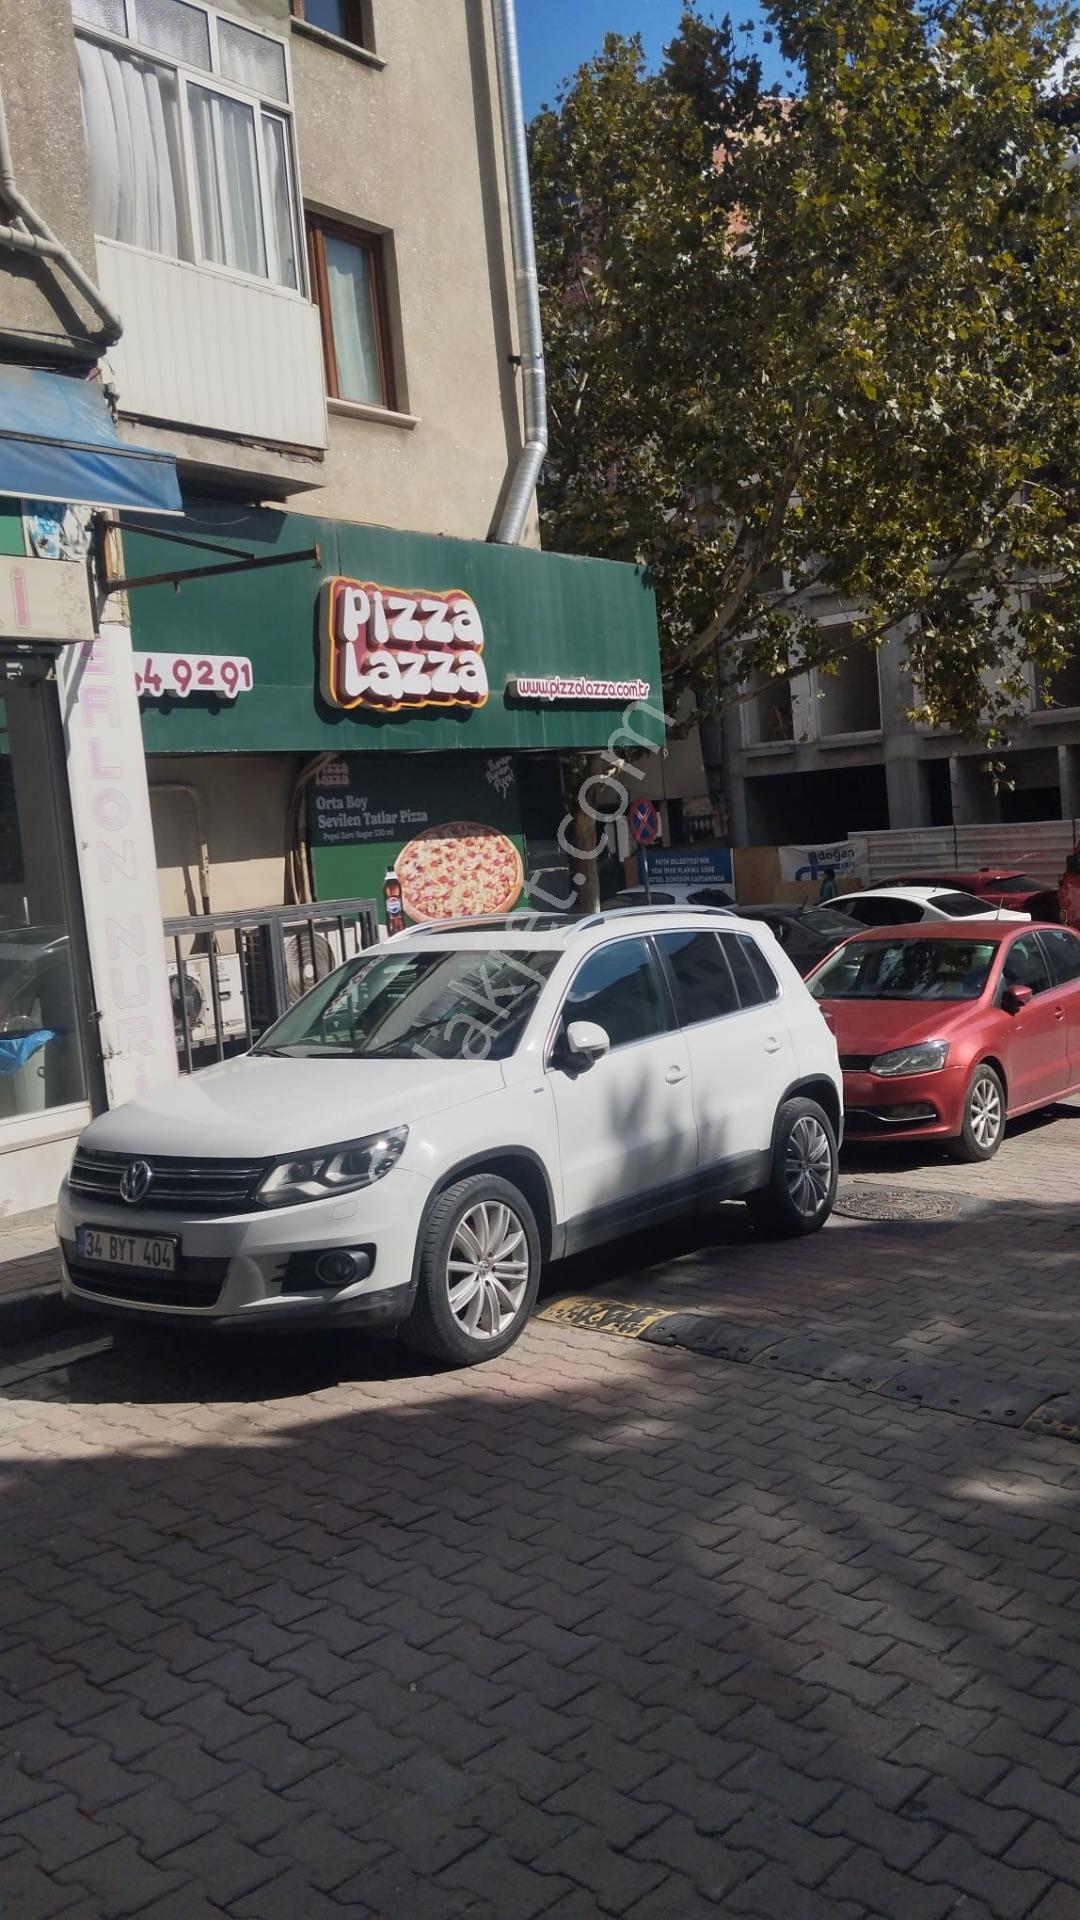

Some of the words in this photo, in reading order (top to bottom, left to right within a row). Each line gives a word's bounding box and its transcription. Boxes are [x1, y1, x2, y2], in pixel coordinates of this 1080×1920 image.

[345, 641, 489, 699] Lazza
[517, 676, 650, 700] www.pizzalazza.com.tr
[315, 796, 344, 811] Orta
[346, 795, 368, 812] Boy
[318, 813, 362, 829] Sevilen
[363, 811, 399, 825] Tatlar
[399, 809, 429, 823] Pizza
[86, 1232, 102, 1257] 34
[109, 1236, 136, 1262] BYT
[143, 1241, 171, 1268] 404
